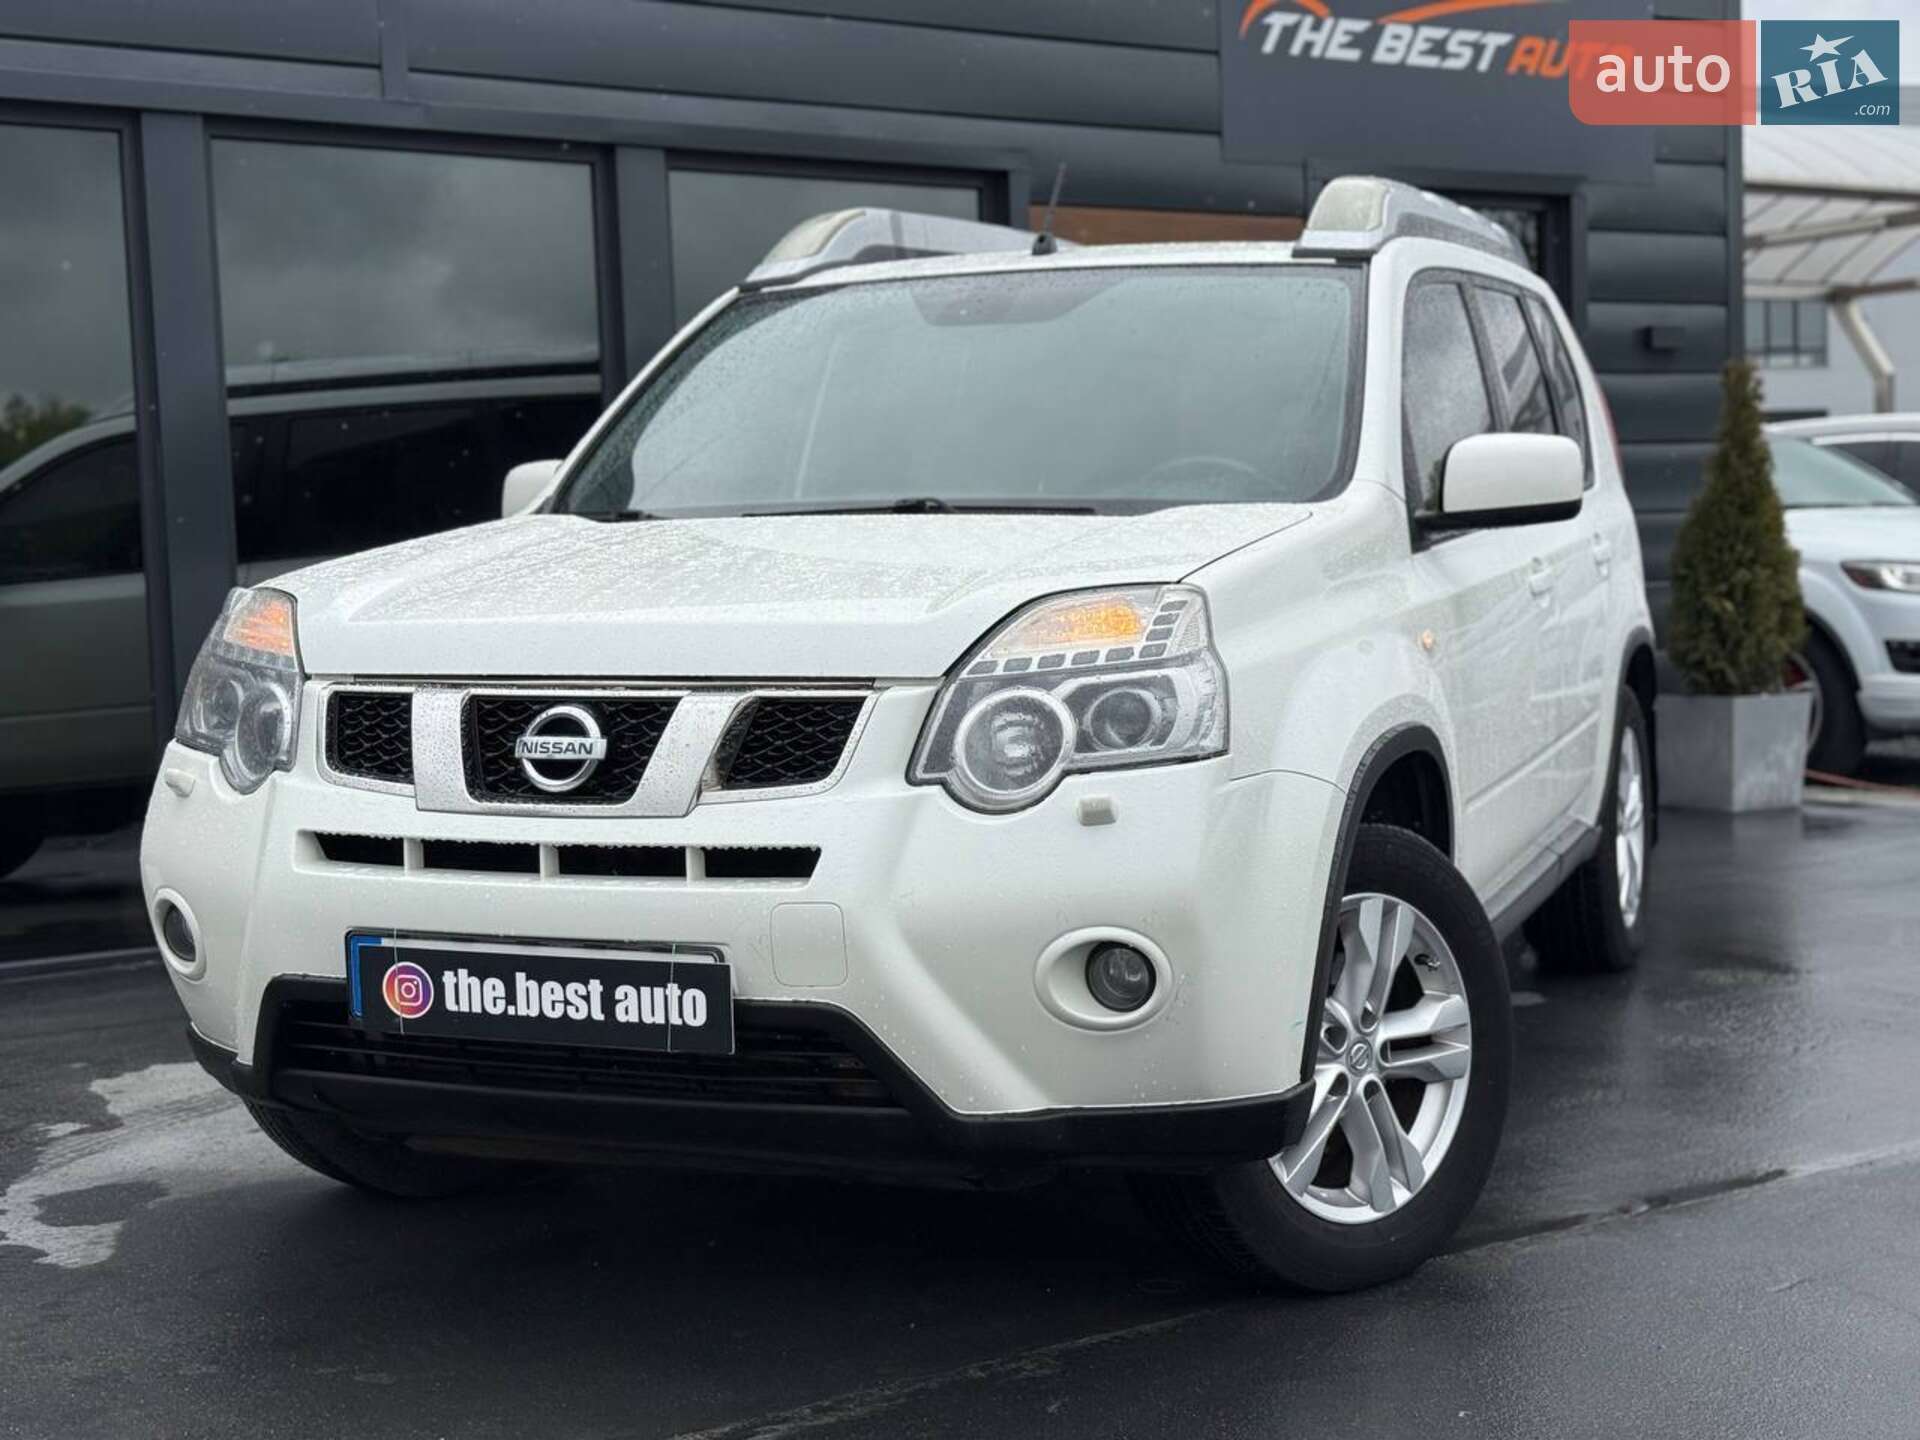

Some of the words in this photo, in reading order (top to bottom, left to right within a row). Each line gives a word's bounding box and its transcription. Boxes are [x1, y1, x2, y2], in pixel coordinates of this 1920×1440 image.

[1261, 11, 1372, 62] THE
[1371, 23, 1511, 73] BEST
[521, 741, 594, 755] NISSAN
[442, 968, 604, 1020] the.best
[614, 983, 707, 1027] auto
